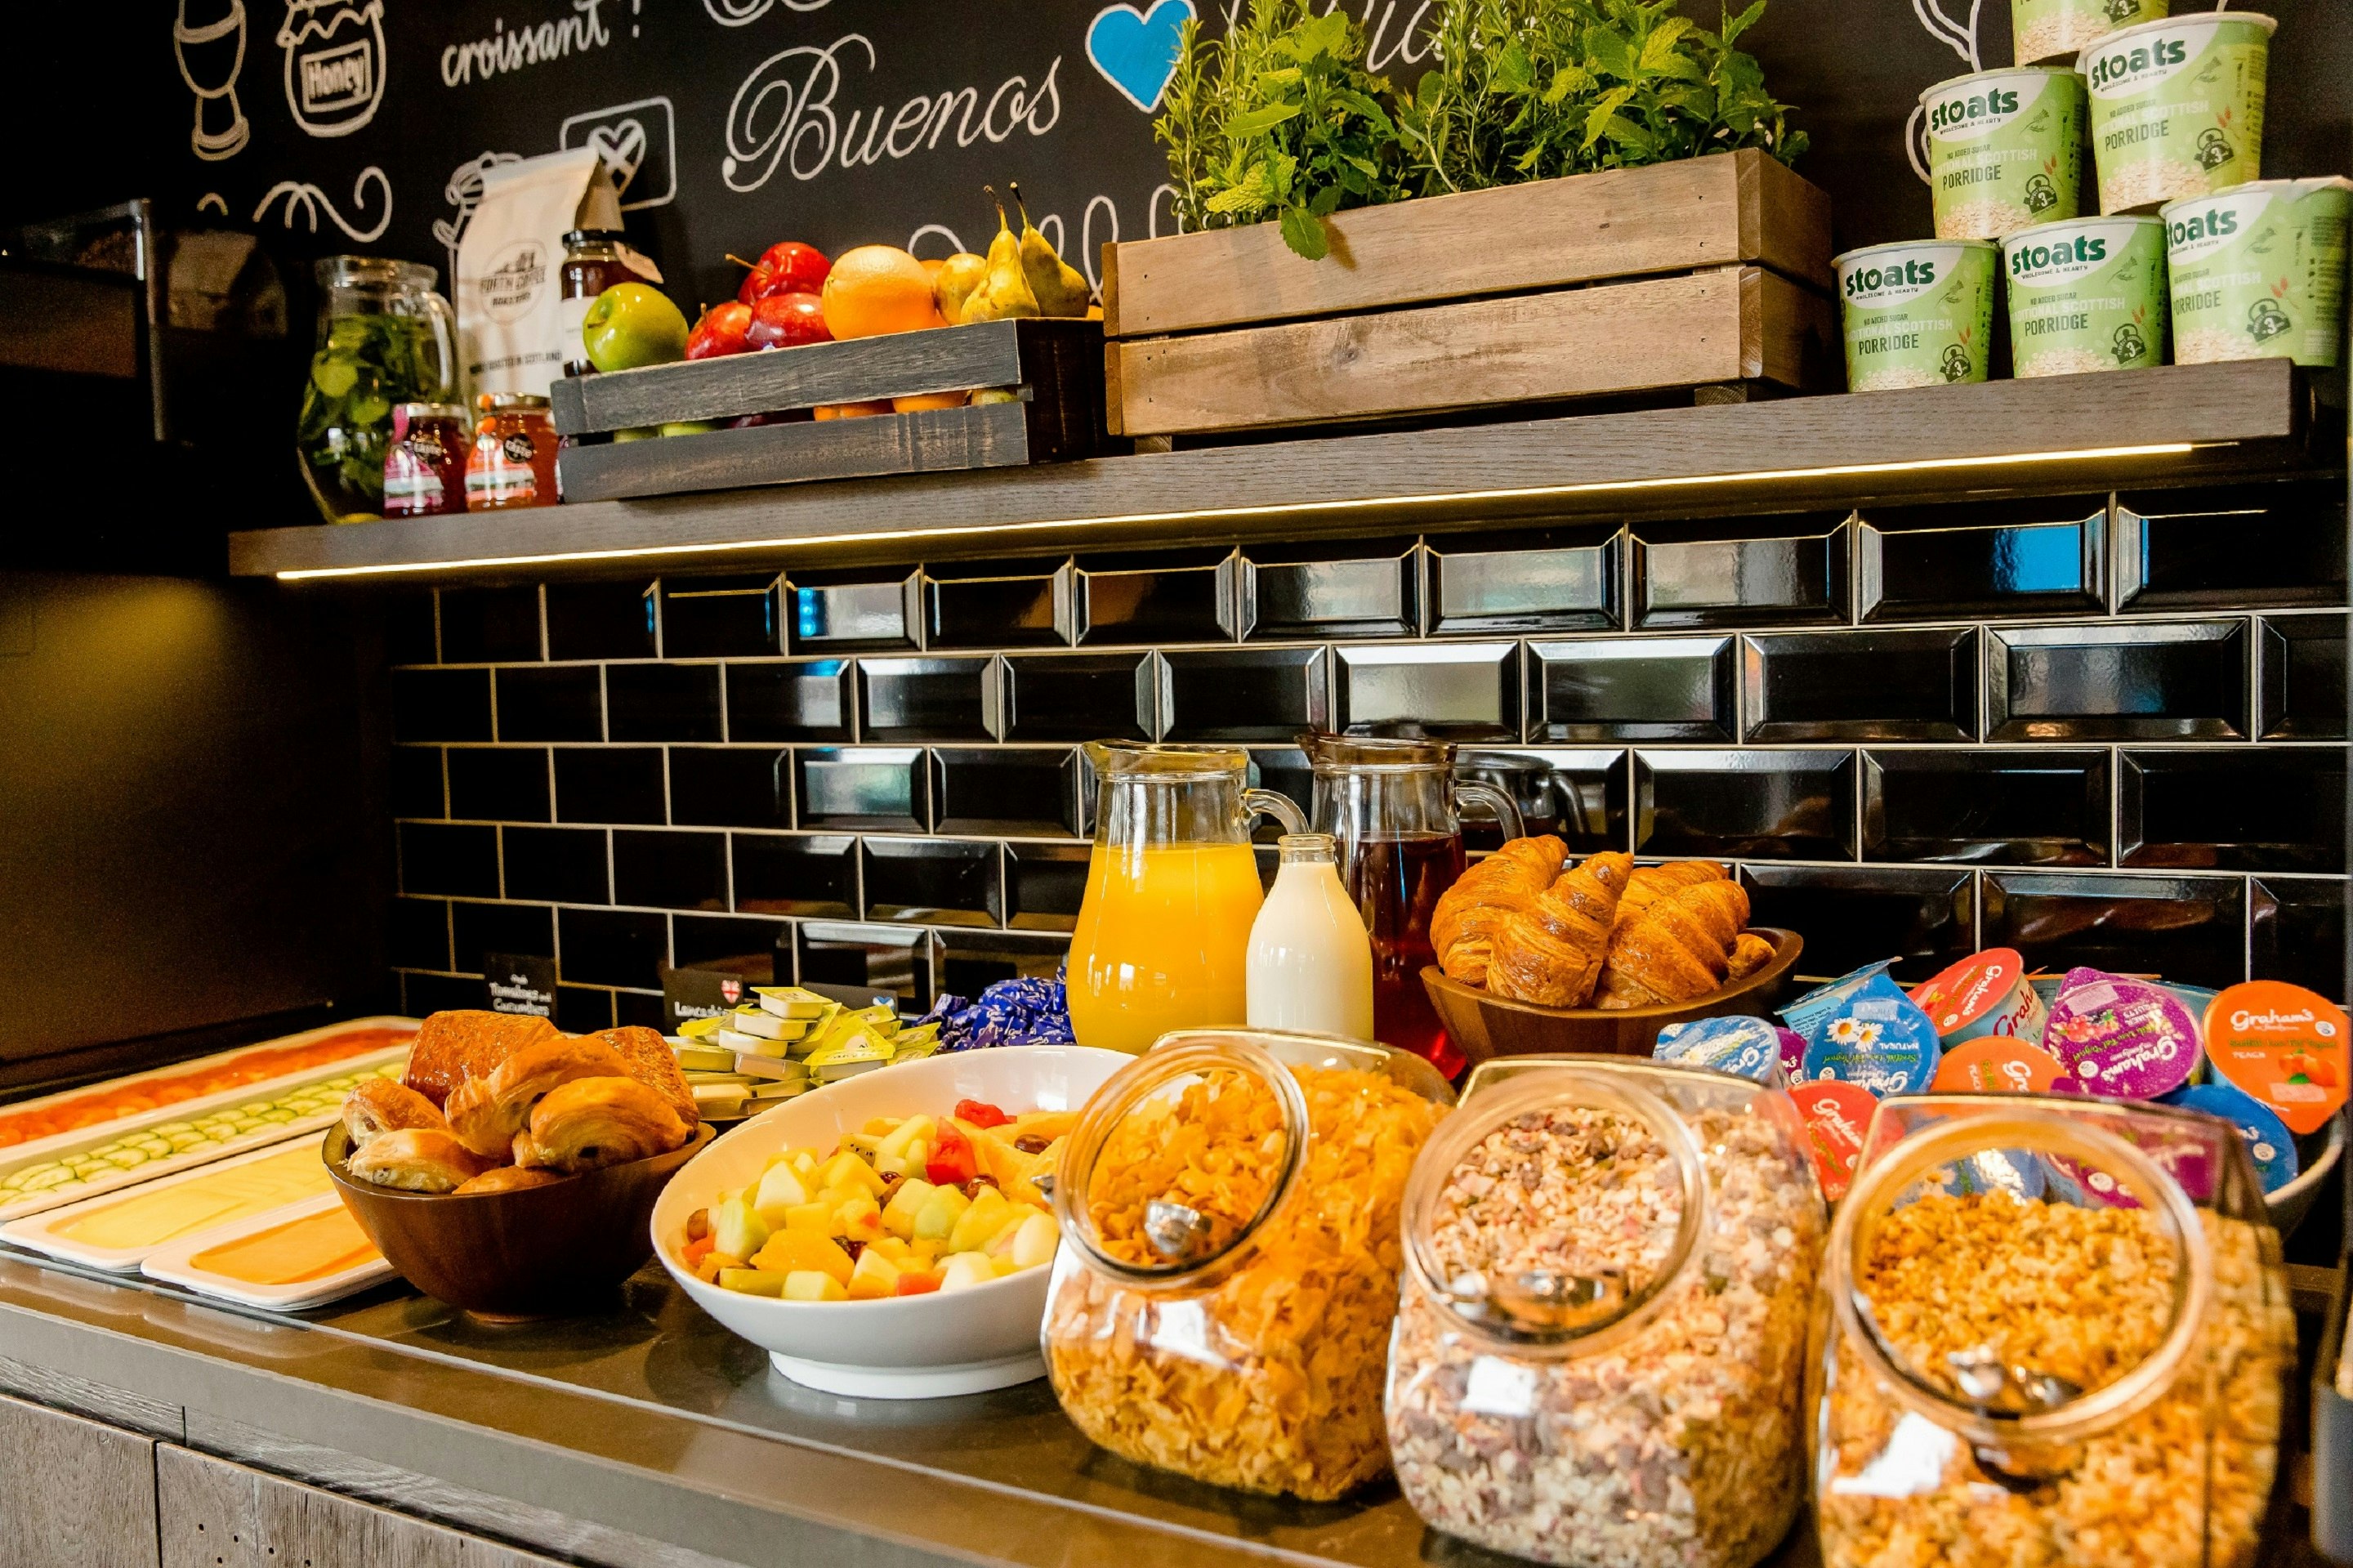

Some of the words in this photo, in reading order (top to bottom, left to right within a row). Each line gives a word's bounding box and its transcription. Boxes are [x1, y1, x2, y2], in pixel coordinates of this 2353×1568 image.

[308, 55, 364, 99] Honey
[2092, 38, 2186, 90] stoats
[722, 34, 1061, 192] Buenos
[1931, 88, 2019, 132] stoats
[2105, 119, 2169, 152] PORRIDGE
[1977, 149, 2037, 165] SCOTTISH
[1943, 164, 2001, 191] PORRIDGE
[2167, 209, 2238, 248] toats
[2012, 235, 2106, 275] stoats
[1846, 259, 1935, 297] stoats
[2061, 297, 2124, 314] SCOTTISH
[2173, 290, 2221, 316] PORRIDGE
[1894, 319, 1953, 333] SCOTTISH
[2025, 314, 2088, 337] PORRIDGE
[1859, 333, 1918, 355] PORRIDGE
[1879, 1042, 1919, 1050] NATURAL
